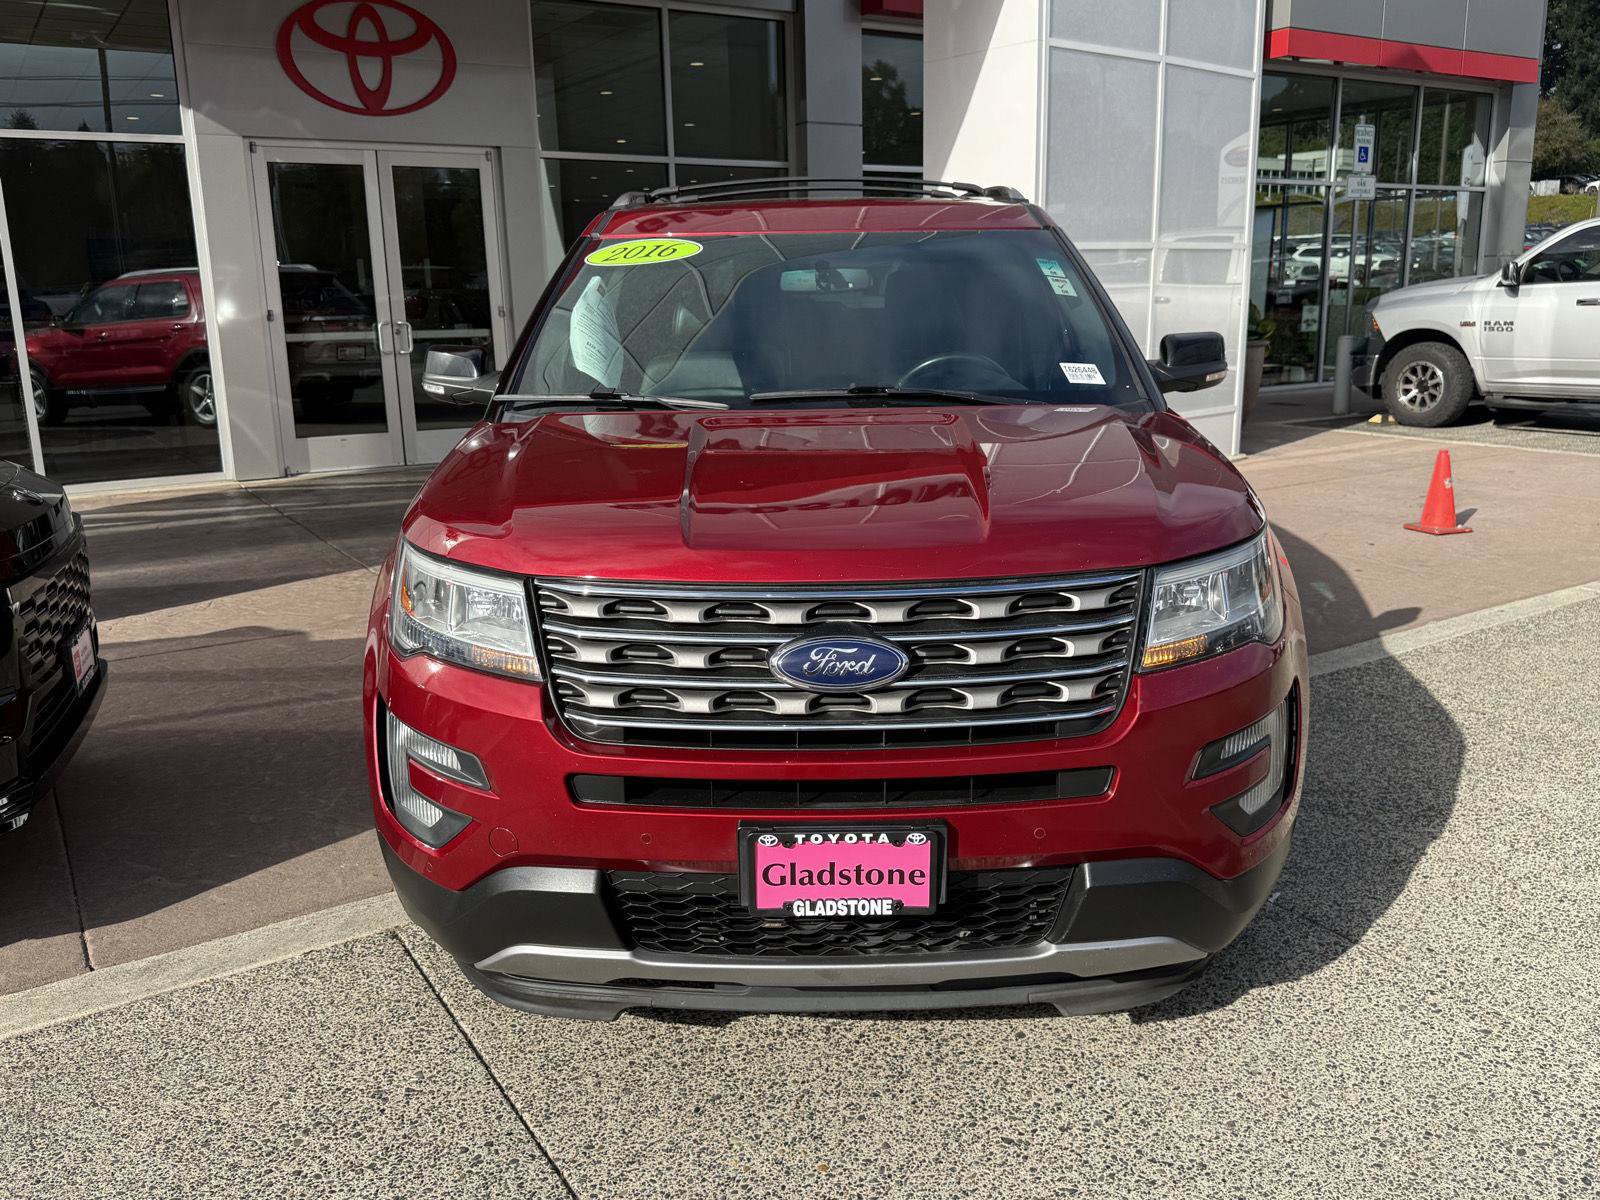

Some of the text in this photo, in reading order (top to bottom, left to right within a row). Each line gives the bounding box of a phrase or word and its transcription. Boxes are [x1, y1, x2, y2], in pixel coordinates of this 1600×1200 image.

[602, 243, 685, 262] 2016
[803, 646, 877, 677] Ford
[794, 833, 890, 844] TOYOTA
[762, 862, 926, 886] Gladstone
[792, 899, 893, 917] GLADSTONE
